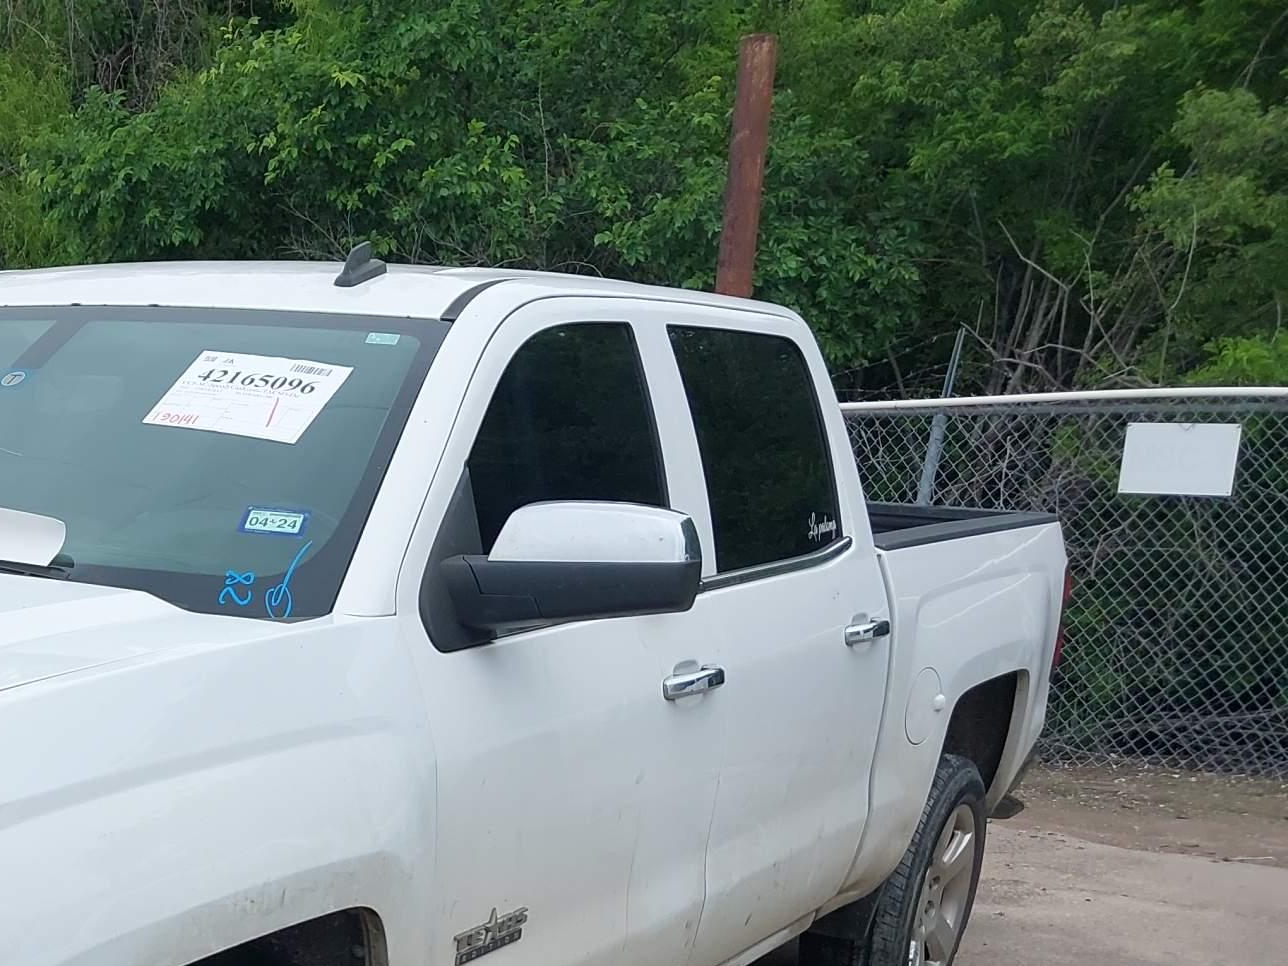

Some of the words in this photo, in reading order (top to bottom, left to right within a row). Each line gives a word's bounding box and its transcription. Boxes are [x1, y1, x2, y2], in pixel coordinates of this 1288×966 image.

[198, 368, 320, 395] 42165096
[248, 516, 269, 527] 04
[276, 518, 298, 530] 24
